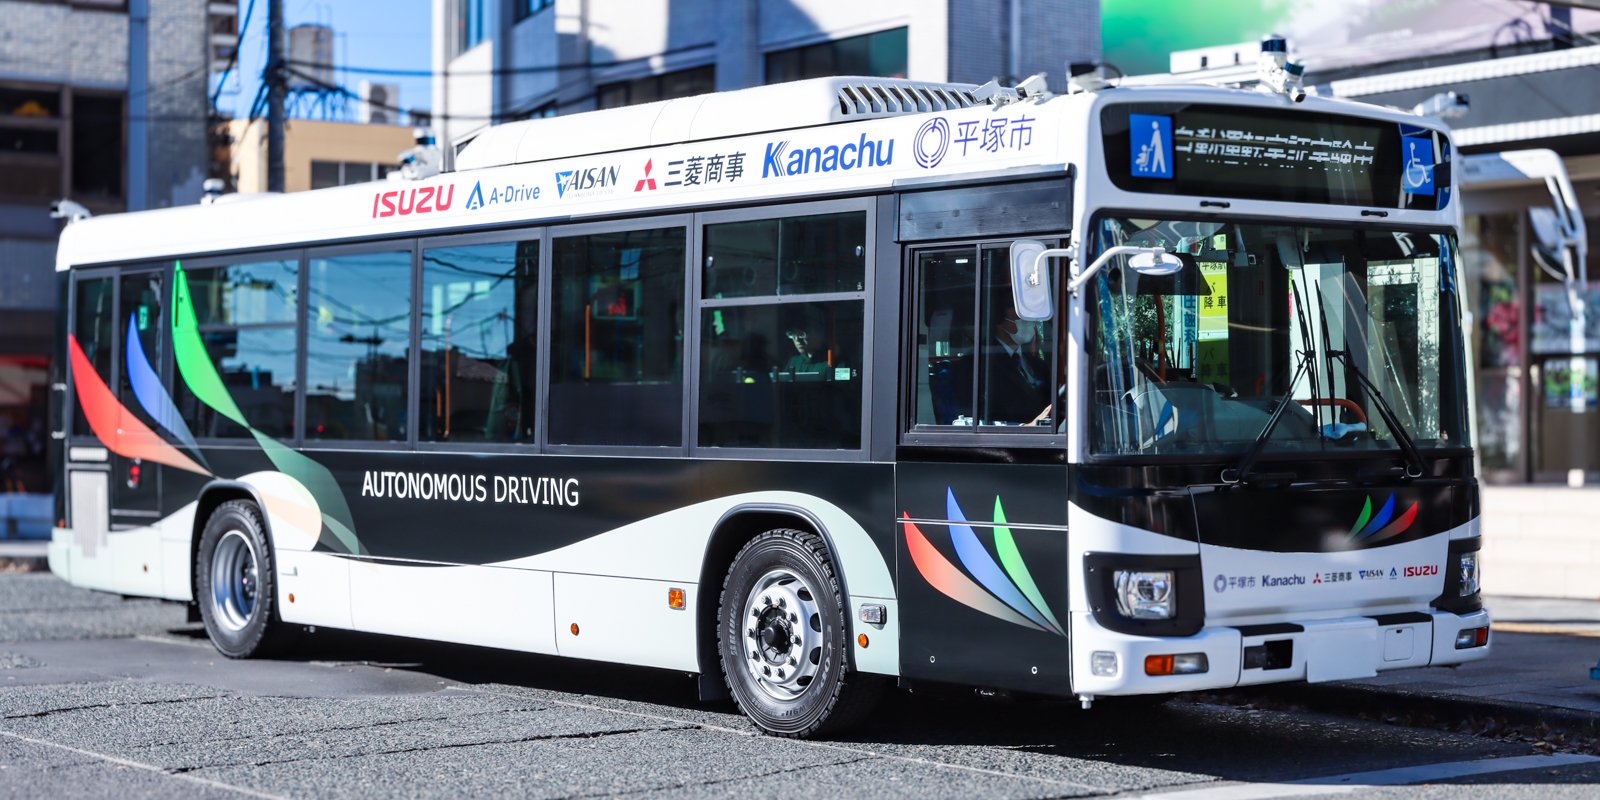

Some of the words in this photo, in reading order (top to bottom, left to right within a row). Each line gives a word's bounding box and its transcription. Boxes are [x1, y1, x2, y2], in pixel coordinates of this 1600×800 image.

[954, 114, 1036, 157] 平塚市
[664, 151, 747, 187] 三菱商事
[762, 132, 894, 178] Kanachu
[372, 184, 454, 218] ISUZU
[489, 186, 540, 205] A-Drive
[361, 470, 487, 502] AUTONOMOUS
[494, 476, 579, 506] DRIVING
[1262, 573, 1306, 587] Kanachu
[1403, 565, 1438, 577] ISUZU
